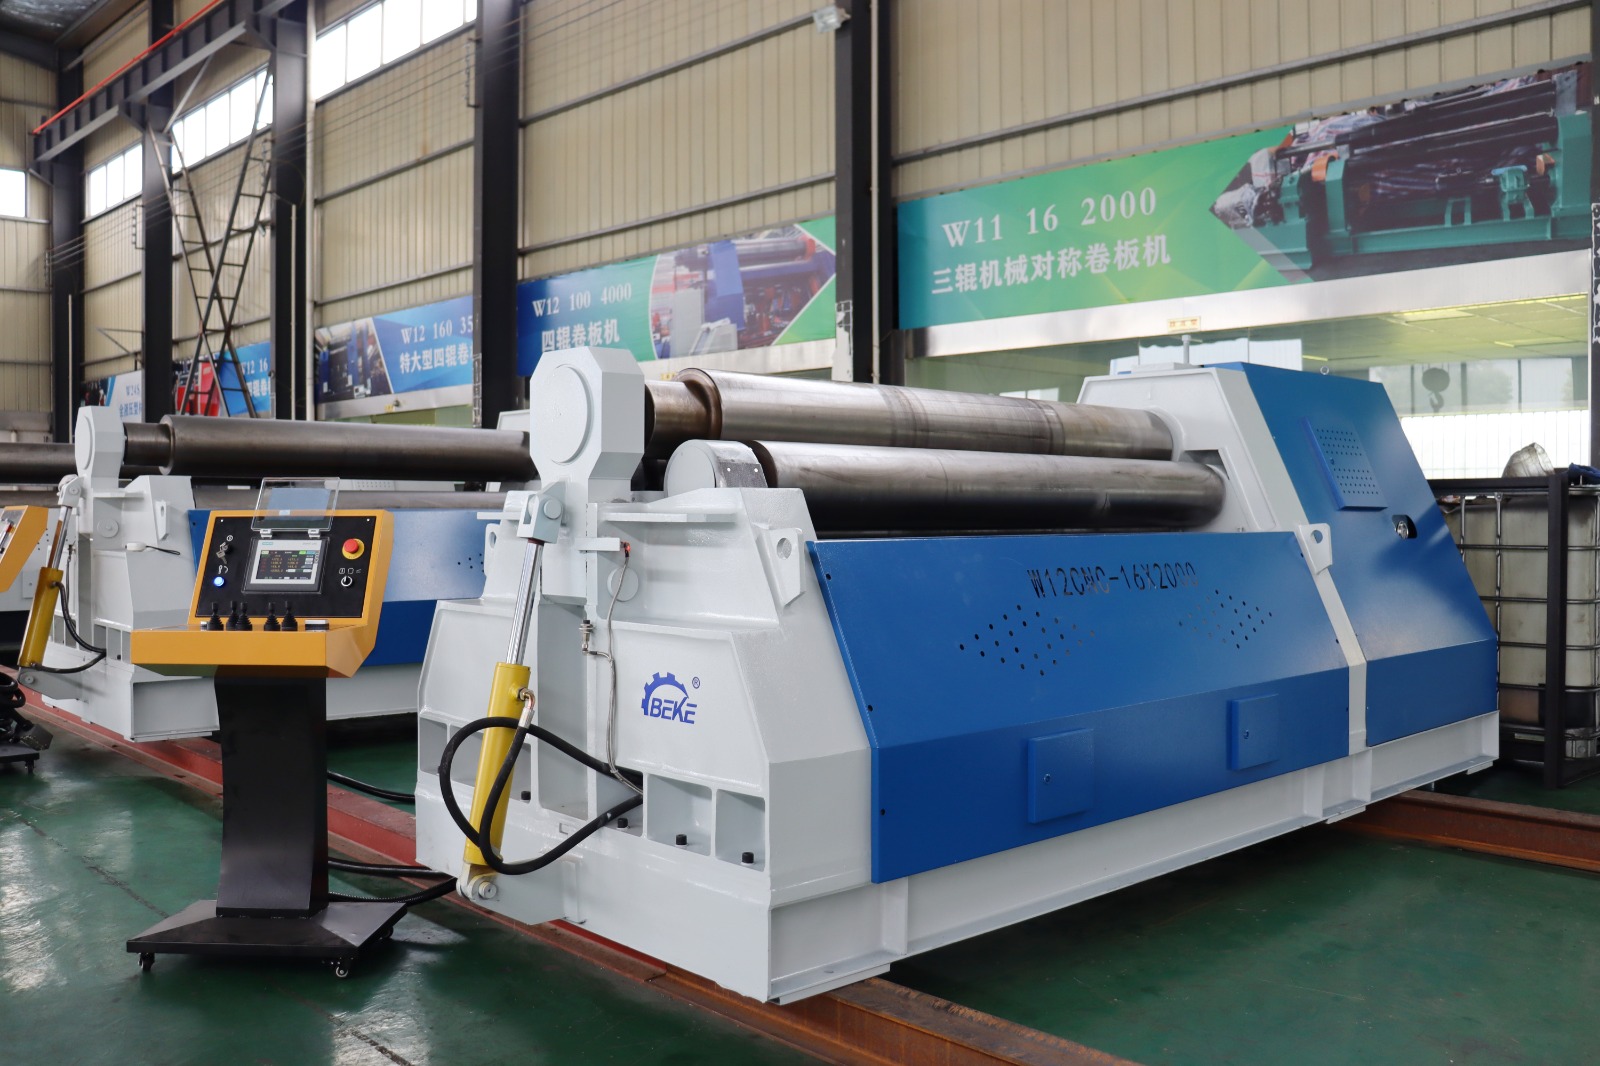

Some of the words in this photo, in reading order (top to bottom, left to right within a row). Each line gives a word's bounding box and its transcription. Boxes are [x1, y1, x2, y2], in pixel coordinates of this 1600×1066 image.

[942, 213, 1003, 248] W11
[1026, 204, 1058, 235] 16
[1081, 187, 1156, 226] 2000
[931, 234, 1171, 294] 三辊机械对称卷板机
[533, 296, 560, 317] W12
[569, 290, 591, 311] 100
[600, 282, 632, 305] 4000
[400, 324, 426, 344] W12
[433, 319, 453, 339] 160
[400, 343, 473, 374] 特大型四辊卷
[650, 696, 698, 725] BEKE
